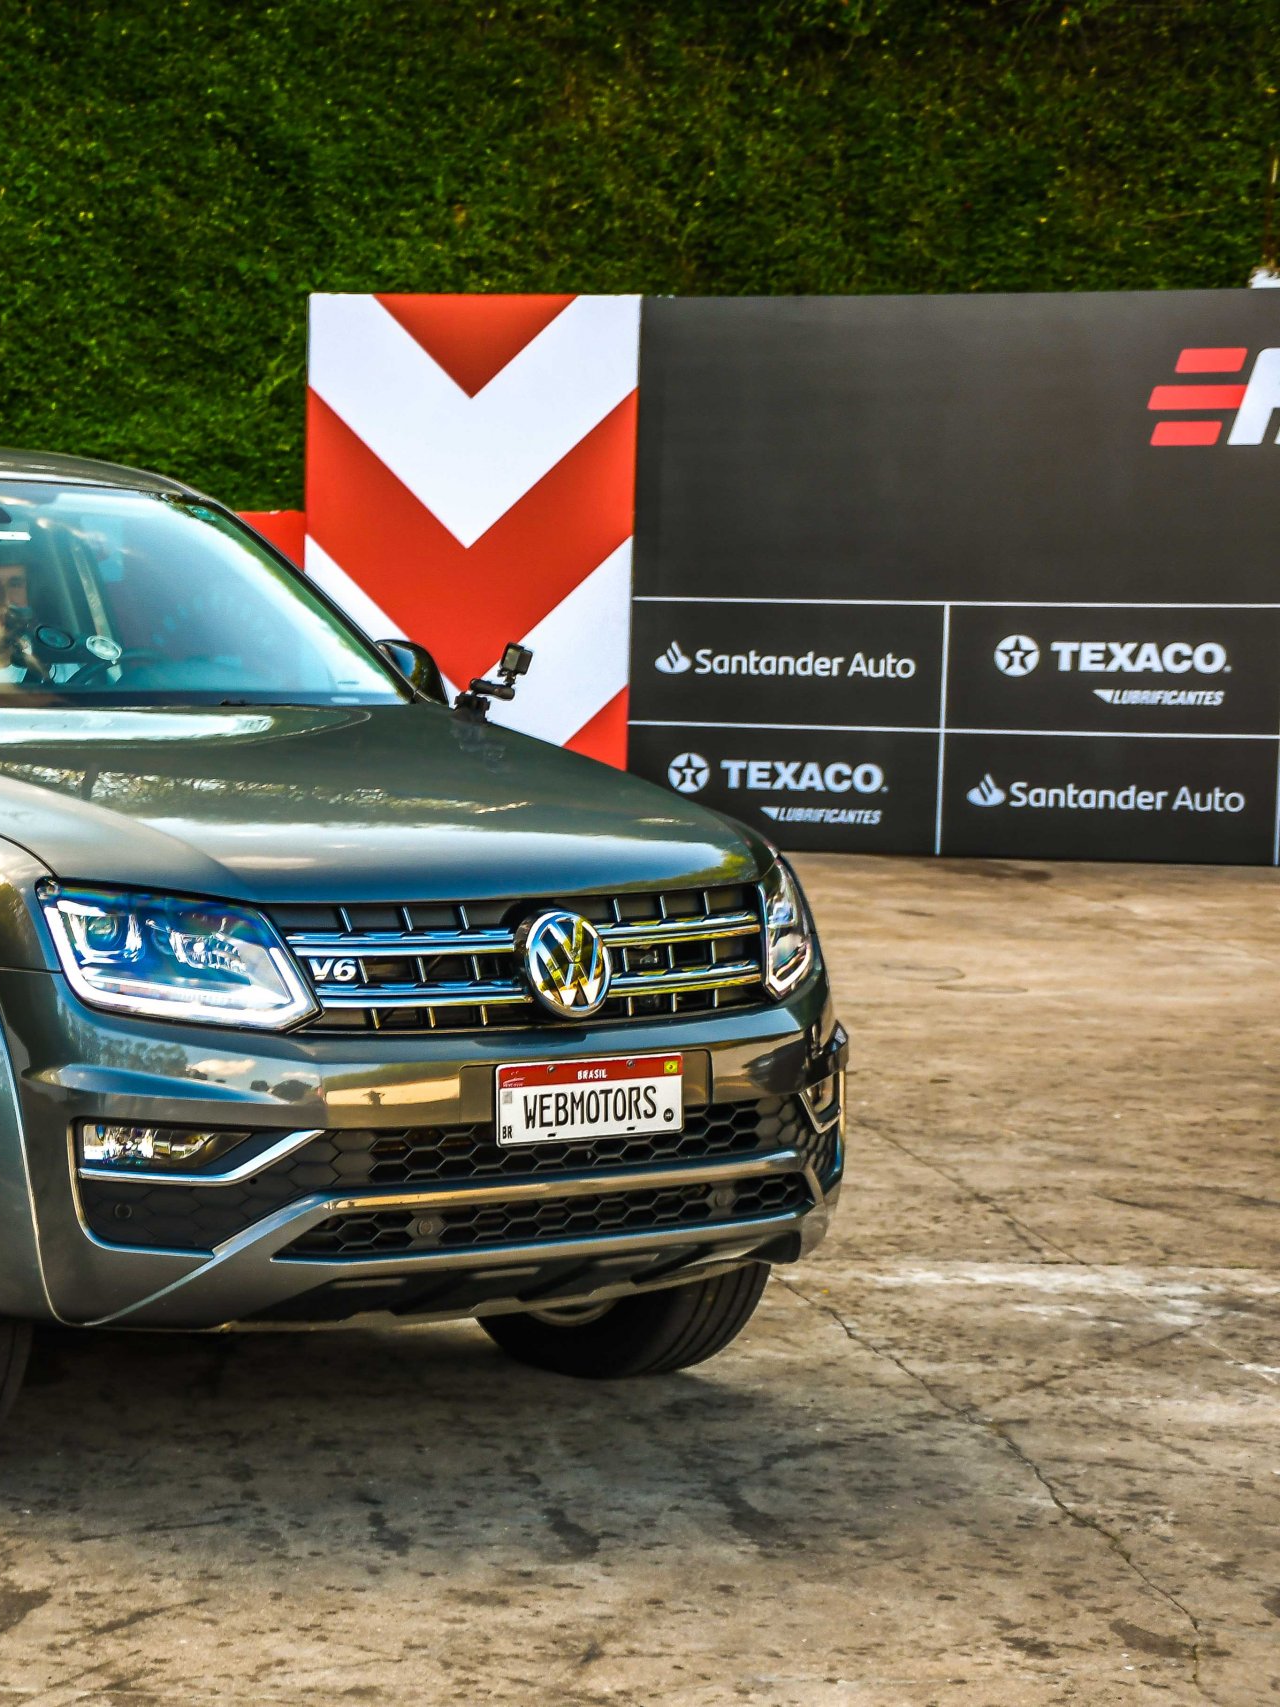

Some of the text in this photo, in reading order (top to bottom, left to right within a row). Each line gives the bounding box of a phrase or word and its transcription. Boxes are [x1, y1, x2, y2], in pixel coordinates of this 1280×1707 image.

[694, 649, 916, 679] Santander Auto
[1050, 641, 1228, 674] TEXACO
[1112, 689, 1225, 706] LUBRIFICANTES
[720, 759, 884, 793] TEXACO
[1009, 781, 1246, 812] Santander Auto
[778, 806, 883, 825] LUBRIFICANTES
[309, 958, 357, 981] V6
[577, 1069, 608, 1080] BRASIL
[523, 1085, 657, 1129] WEBMOTORS
[502, 1125, 513, 1139] BR
